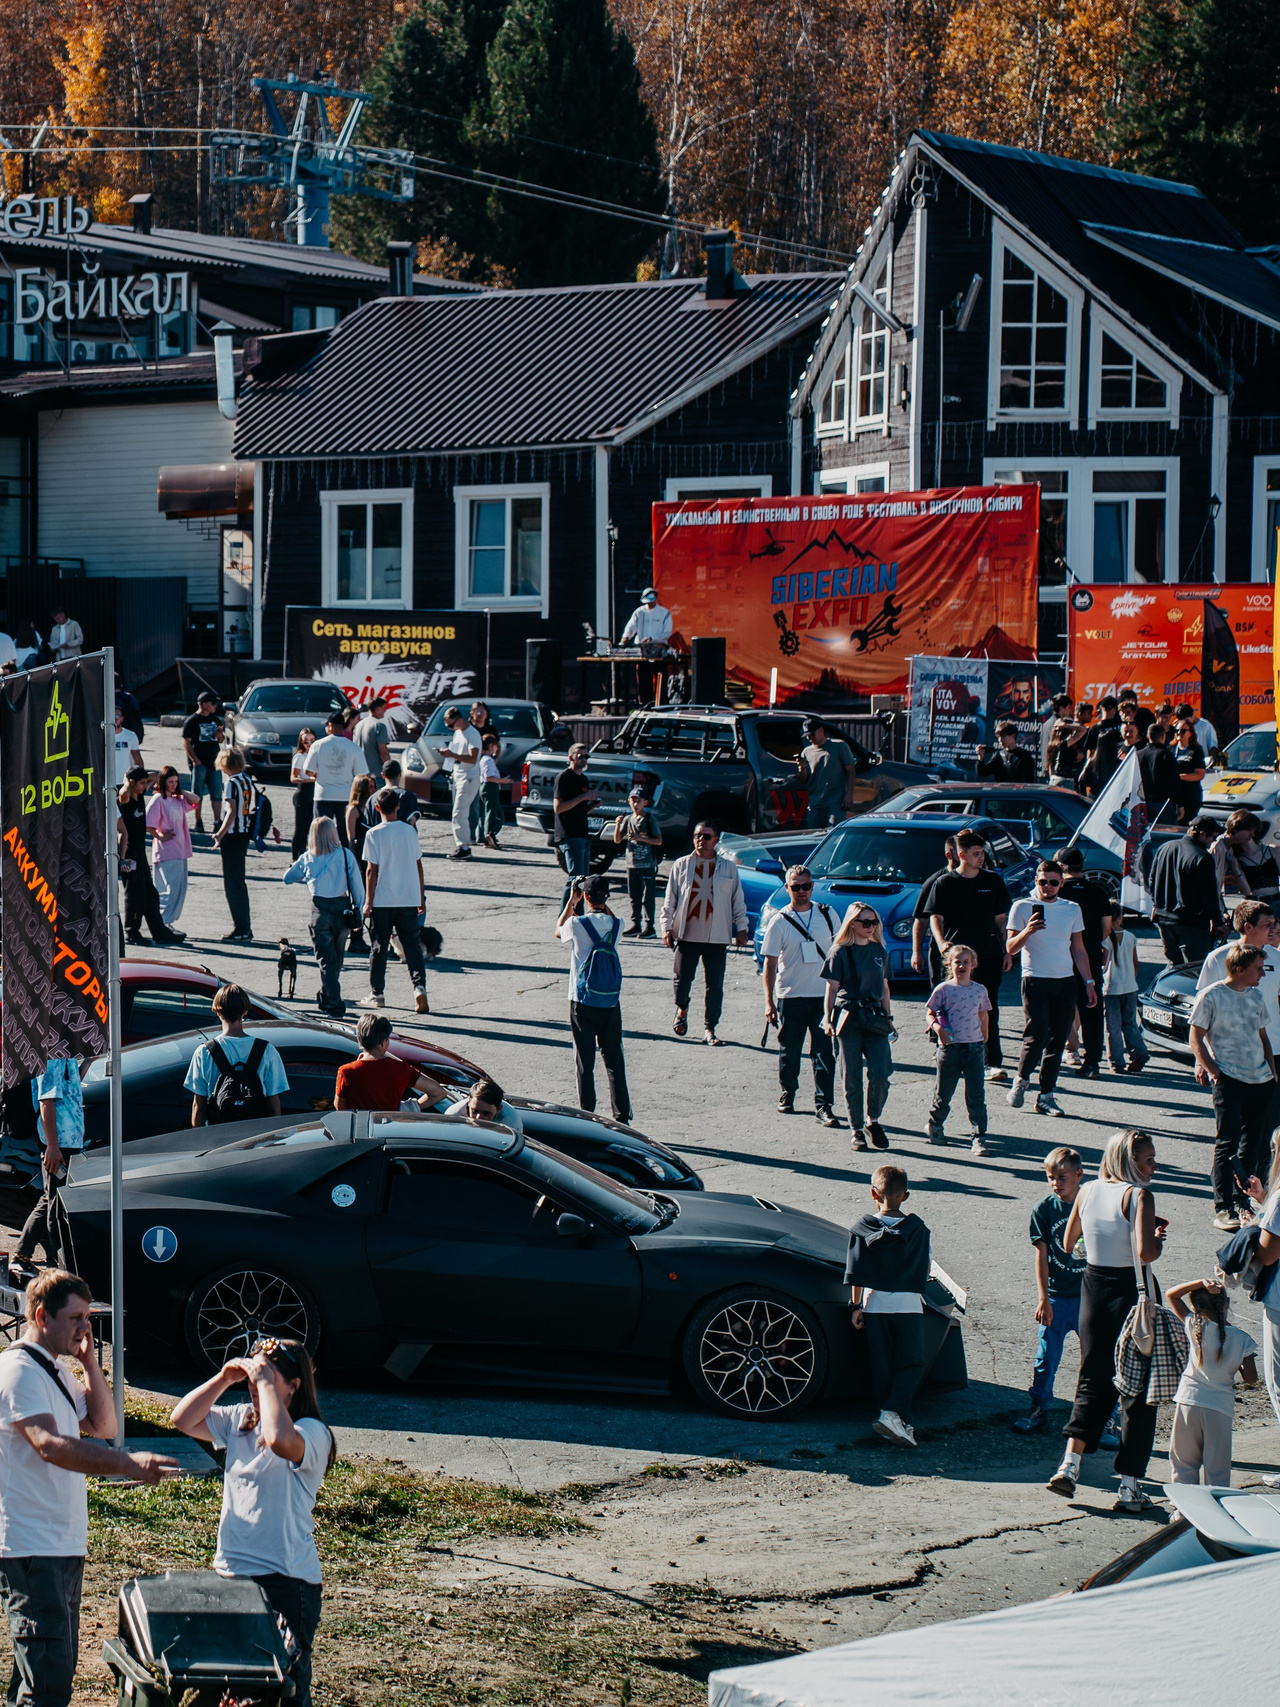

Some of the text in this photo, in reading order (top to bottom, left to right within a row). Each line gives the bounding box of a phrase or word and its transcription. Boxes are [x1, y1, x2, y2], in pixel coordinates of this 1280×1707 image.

[14, 262, 193, 325] Байкал
[665, 509, 722, 526] УНИКАЛЬНЫЙ
[723, 509, 730, 524] И
[732, 505, 800, 523] ЕДИНСТВЕННЫЙ
[803, 506, 809, 520] В
[842, 503, 864, 519] РОДЕ
[866, 501, 918, 517] ФЕСТИВАЛЬ
[986, 495, 1023, 512] СИБИРИ
[771, 562, 899, 605] SIBERIAN
[312, 619, 456, 640] Сеть магазинов
[792, 596, 870, 631] EXPO
[340, 640, 432, 658] автозвука
[1122, 641, 1168, 649] JETOUR
[338, 675, 407, 710] RIVE
[21, 767, 94, 816] 12 ВОЬТ
[531, 775, 629, 793] CHGAN
[3, 826, 108, 1025] АККУМУТОРЫ
